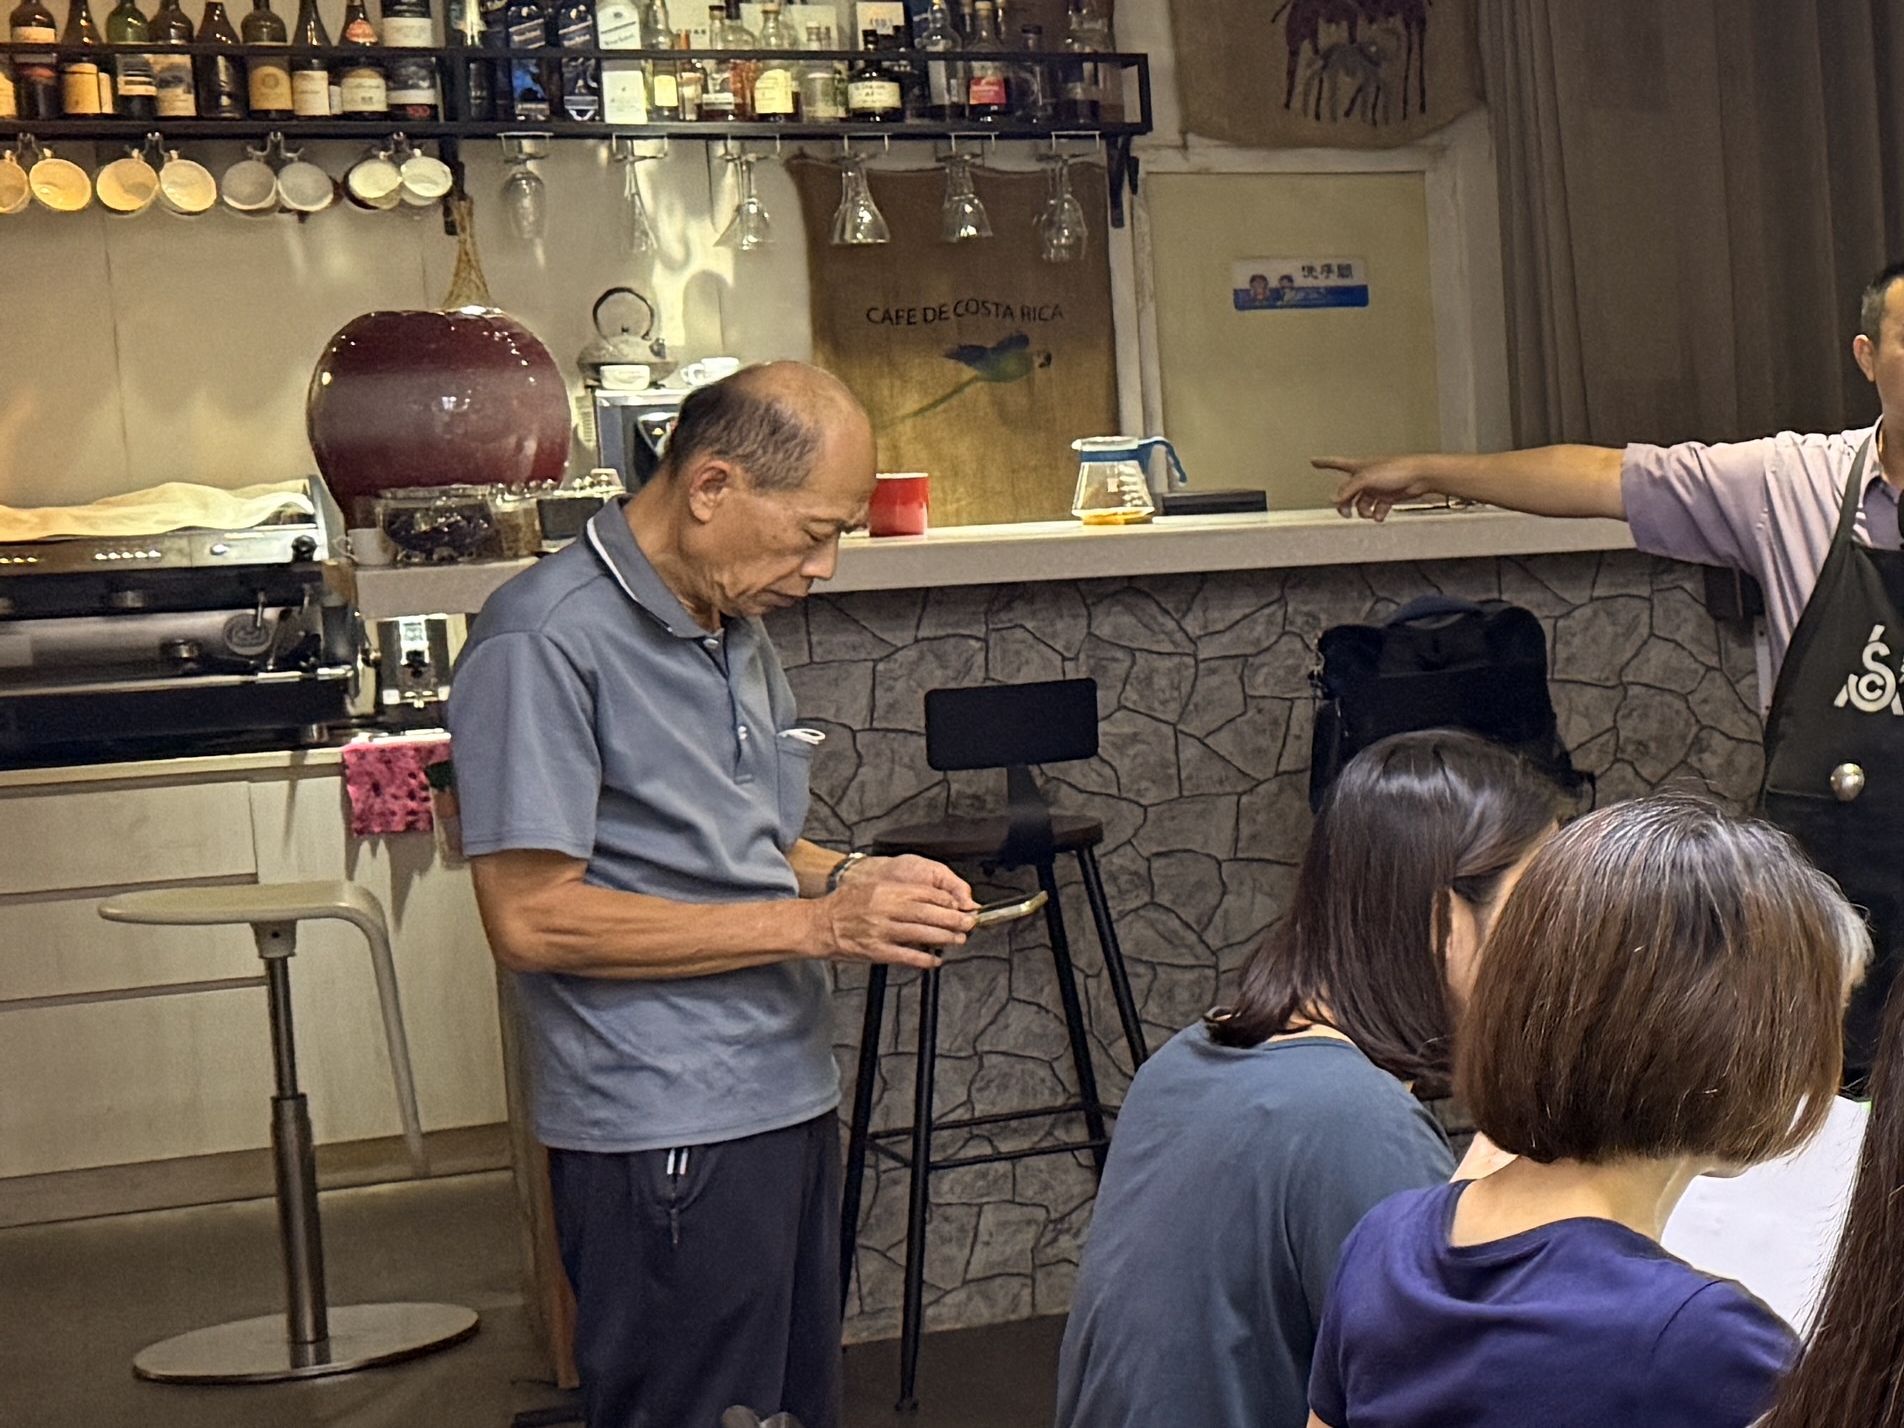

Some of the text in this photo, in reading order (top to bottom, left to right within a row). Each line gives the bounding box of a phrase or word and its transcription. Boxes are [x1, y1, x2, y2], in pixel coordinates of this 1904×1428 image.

[866, 297, 1065, 326] CAFE DE COSTA RICA
